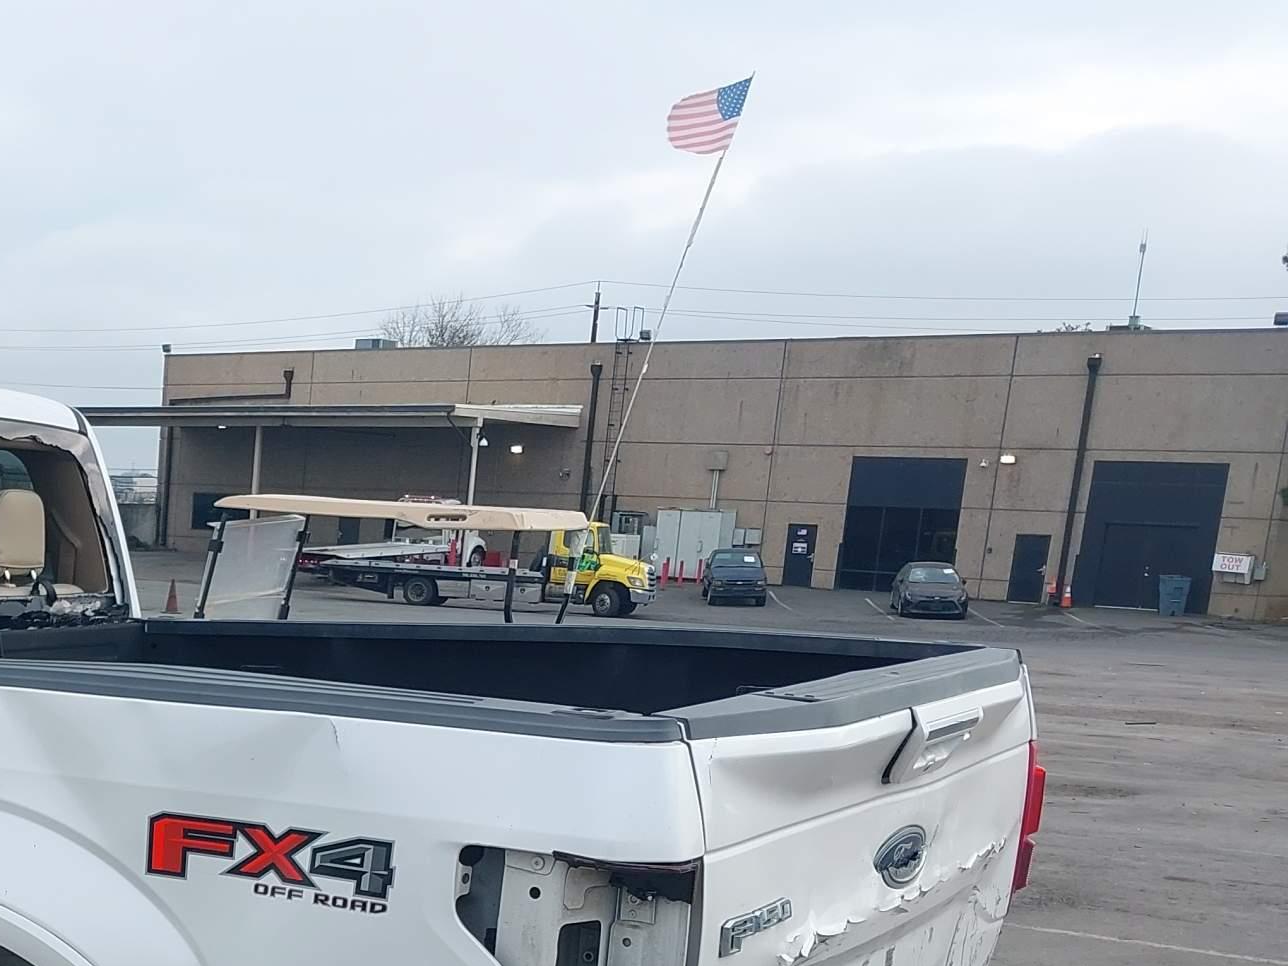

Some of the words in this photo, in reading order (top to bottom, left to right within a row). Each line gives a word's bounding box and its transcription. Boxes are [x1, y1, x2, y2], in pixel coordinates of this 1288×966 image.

[1219, 563, 1241, 571] OUT
[1221, 555, 1244, 564] TOW
[145, 811, 396, 900] FX4
[253, 882, 304, 901] OFF
[313, 892, 388, 915] ROAD
